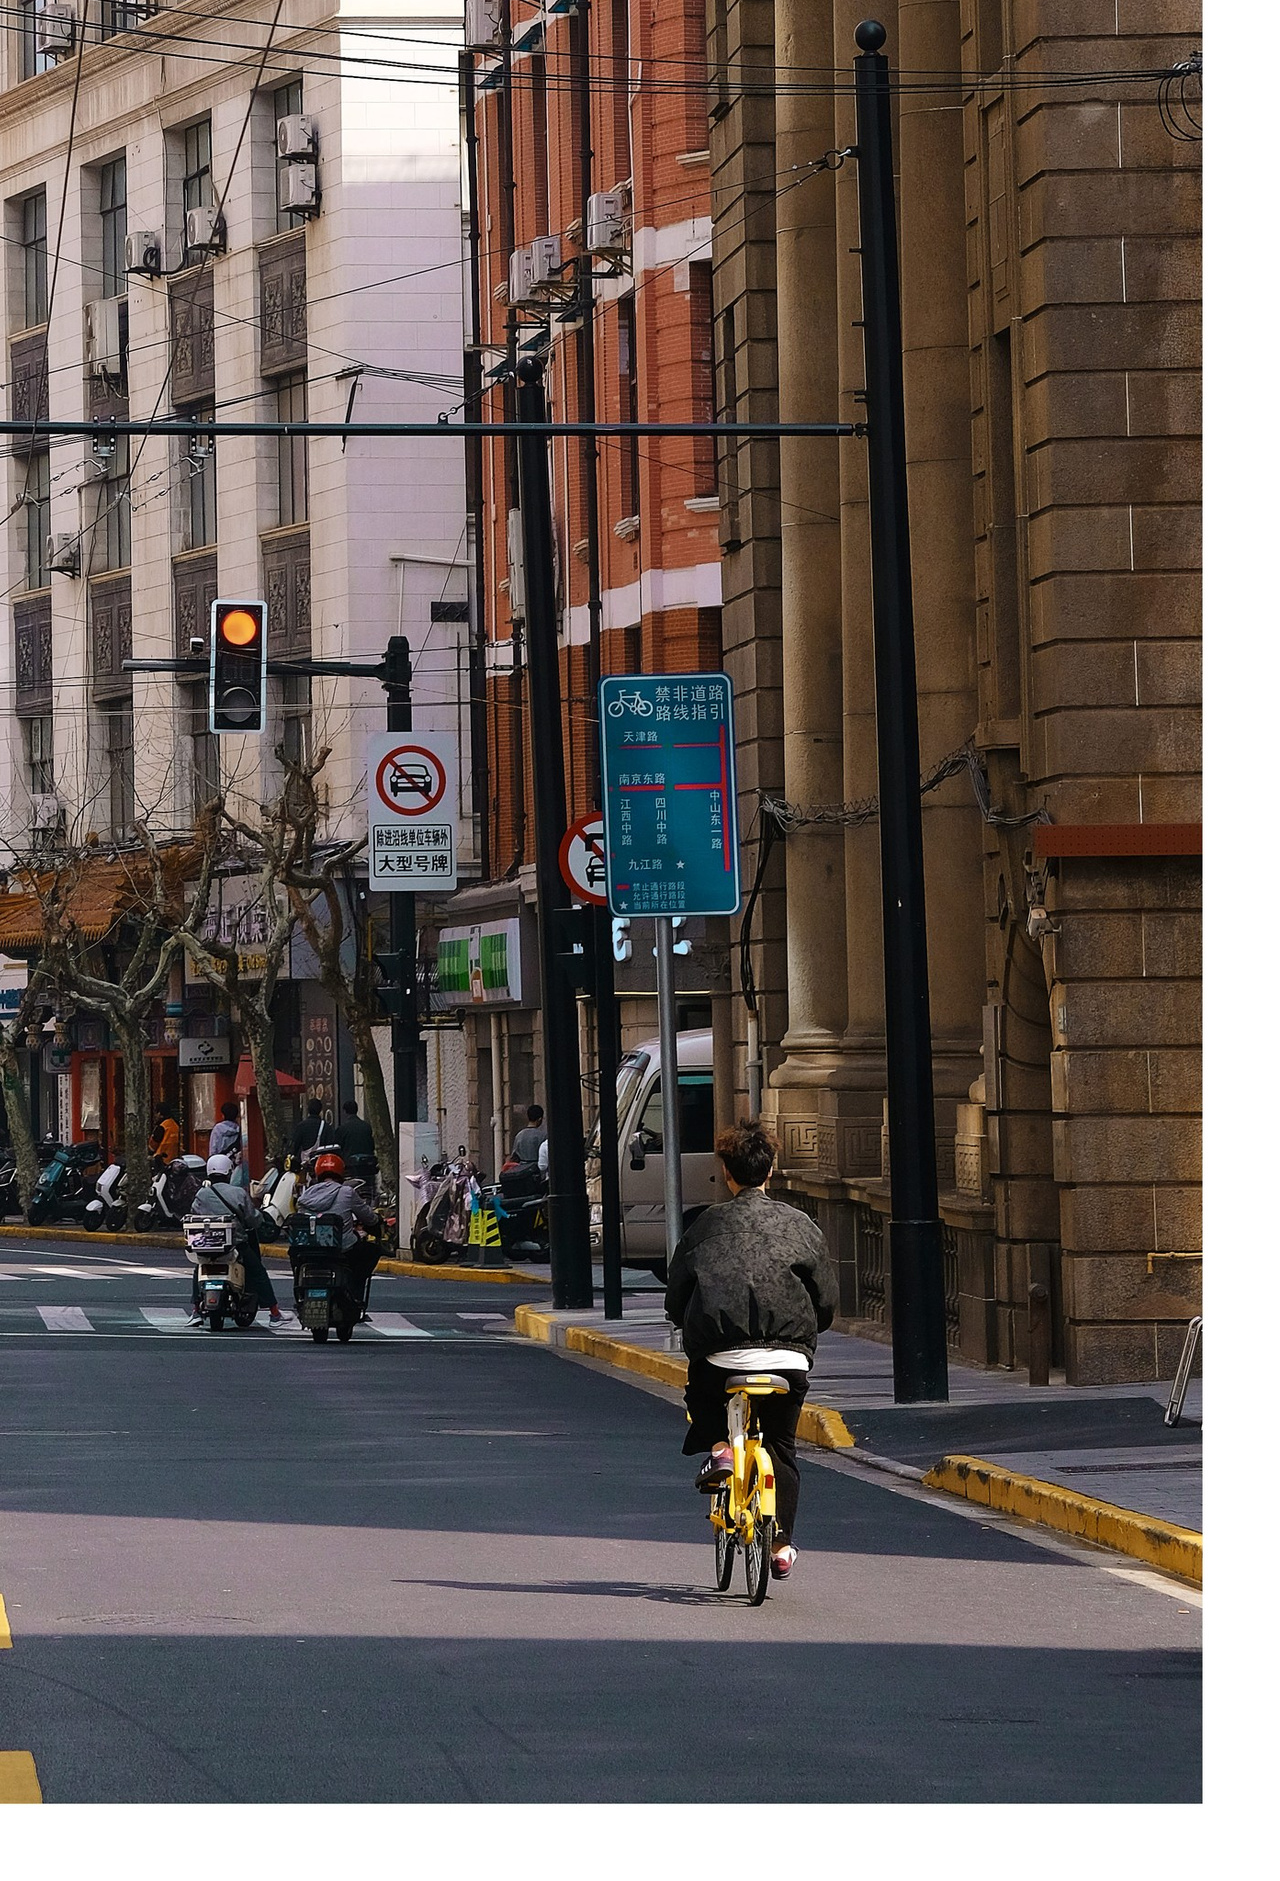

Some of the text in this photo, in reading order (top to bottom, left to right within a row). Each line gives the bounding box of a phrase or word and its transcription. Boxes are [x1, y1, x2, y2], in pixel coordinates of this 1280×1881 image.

[655, 684, 725, 702] 禁非道路
[655, 704, 725, 721] 路线指引
[623, 730, 658, 742] 天津路
[619, 773, 665, 785] 南京东路
[620, 798, 632, 846] 江西中路
[655, 797, 667, 845] 四川中路
[710, 790, 722, 849] 中山东一路
[378, 854, 448, 873] 大型号牌
[628, 859, 663, 871] 九江路
[632, 881, 685, 891] 禁止通行路段
[633, 891, 685, 900] 允许通行路段
[633, 900, 686, 910] 当前所在位置
